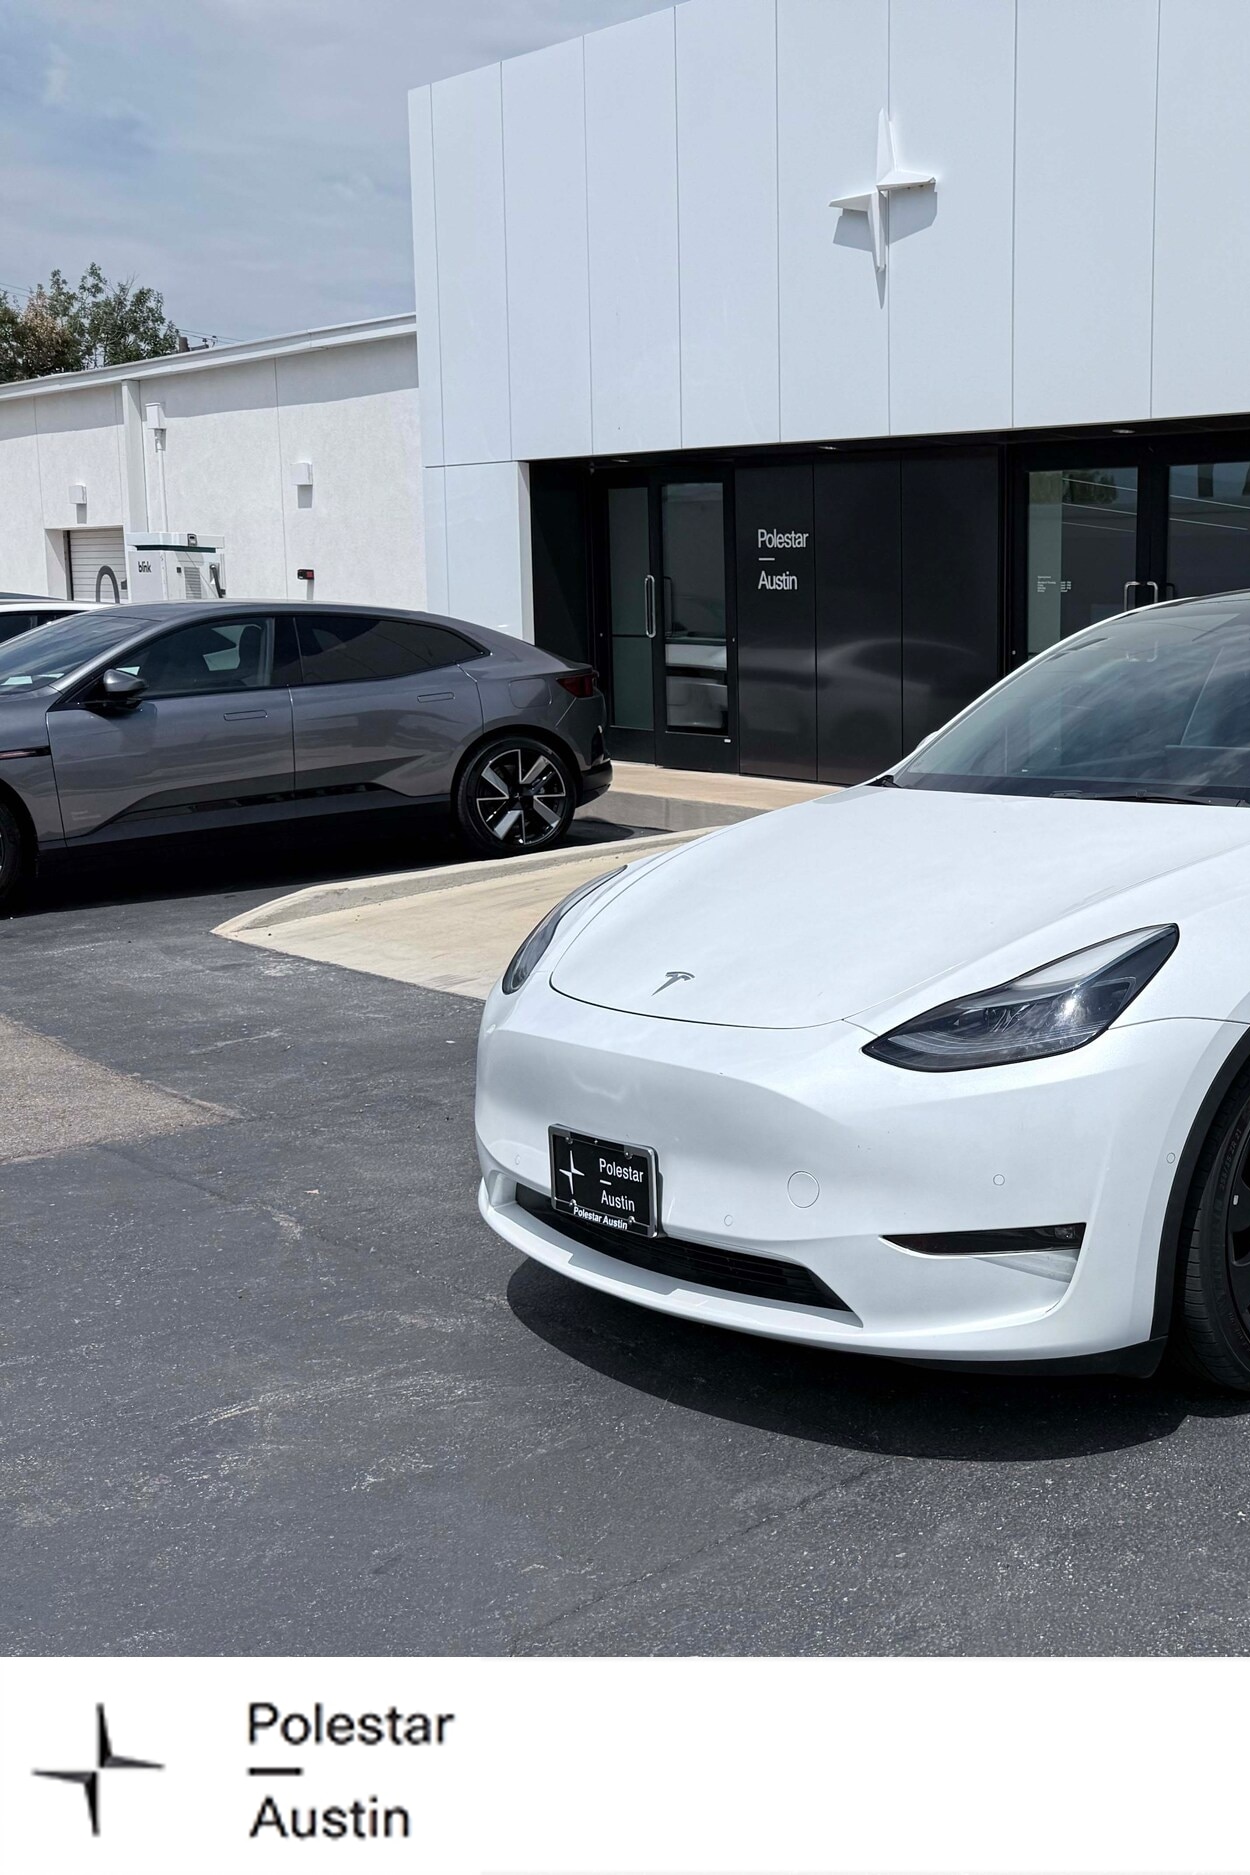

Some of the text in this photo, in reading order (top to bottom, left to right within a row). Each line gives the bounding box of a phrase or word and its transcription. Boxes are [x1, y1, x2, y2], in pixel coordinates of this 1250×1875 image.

[757, 528, 809, 548] Polestar
[138, 561, 152, 573] blink
[757, 570, 798, 590] Austin
[599, 1158, 644, 1182] Polestar
[601, 1190, 635, 1212] Austin
[573, 1206, 628, 1230] Polestar Austin
